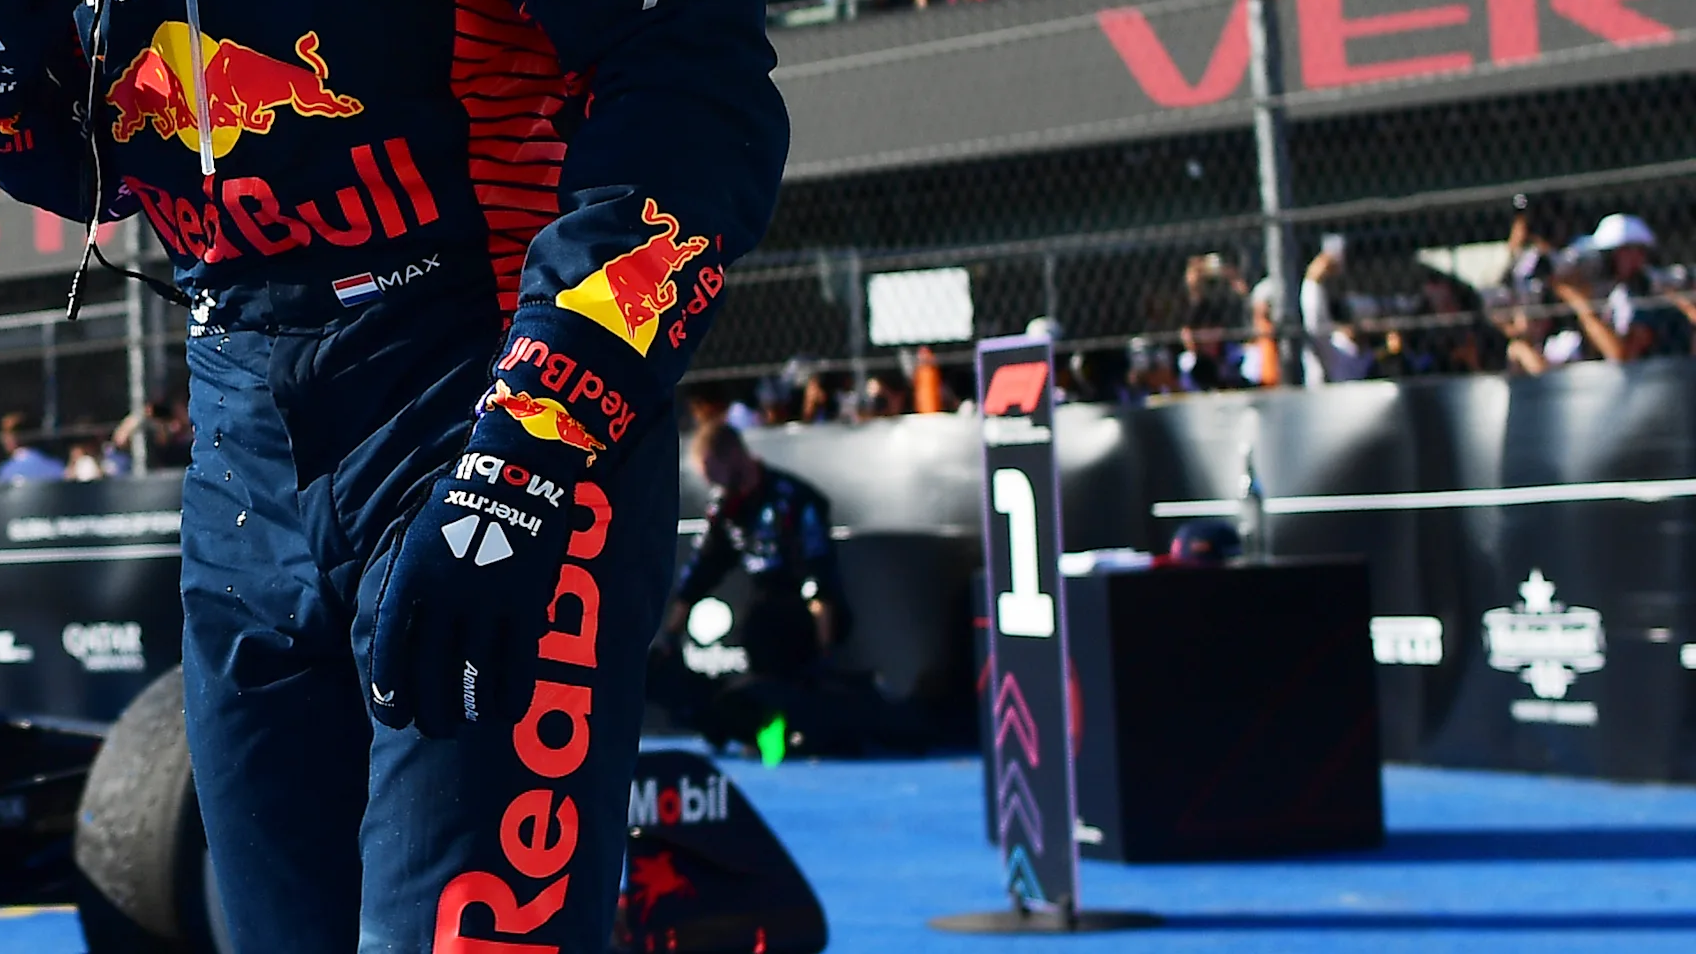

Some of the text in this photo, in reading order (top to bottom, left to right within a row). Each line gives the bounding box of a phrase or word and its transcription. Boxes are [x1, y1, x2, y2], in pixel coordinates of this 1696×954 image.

[221, 137, 440, 257] Bull
[377, 253, 441, 293] MAX
[456, 452, 566, 508] Mobil
[444, 488, 544, 538] inter.mx
[992, 467, 1056, 638] 1
[628, 775, 728, 826] Mobil
